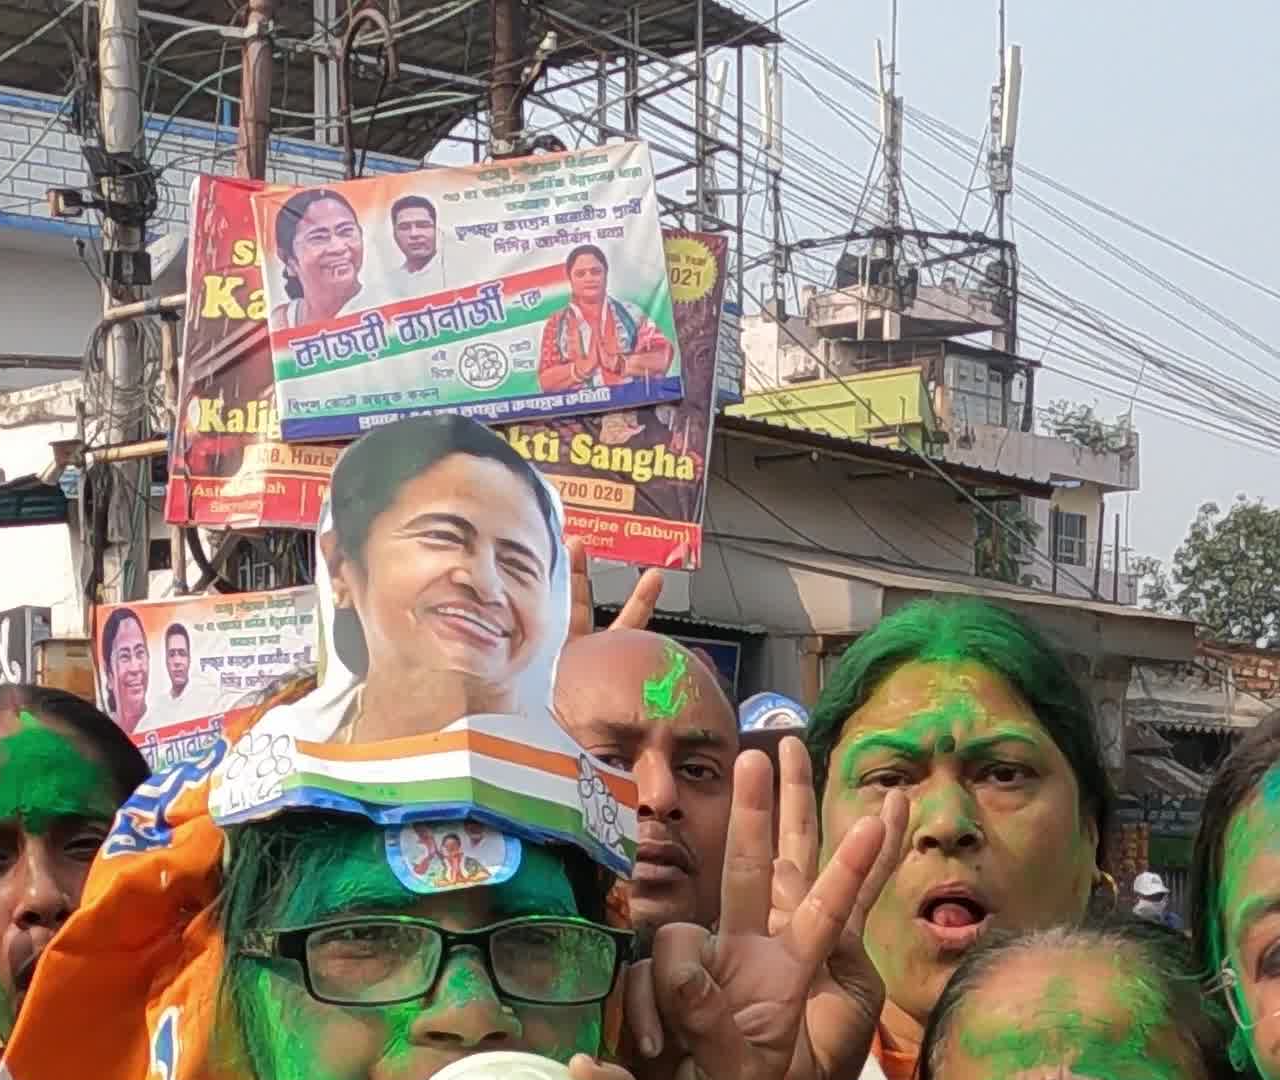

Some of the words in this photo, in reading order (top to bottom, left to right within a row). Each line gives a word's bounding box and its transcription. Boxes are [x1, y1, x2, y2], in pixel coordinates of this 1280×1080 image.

[290, 311, 389, 369] কাজরী
[496, 425, 560, 462] kti
[570, 433, 694, 482] Sangha
